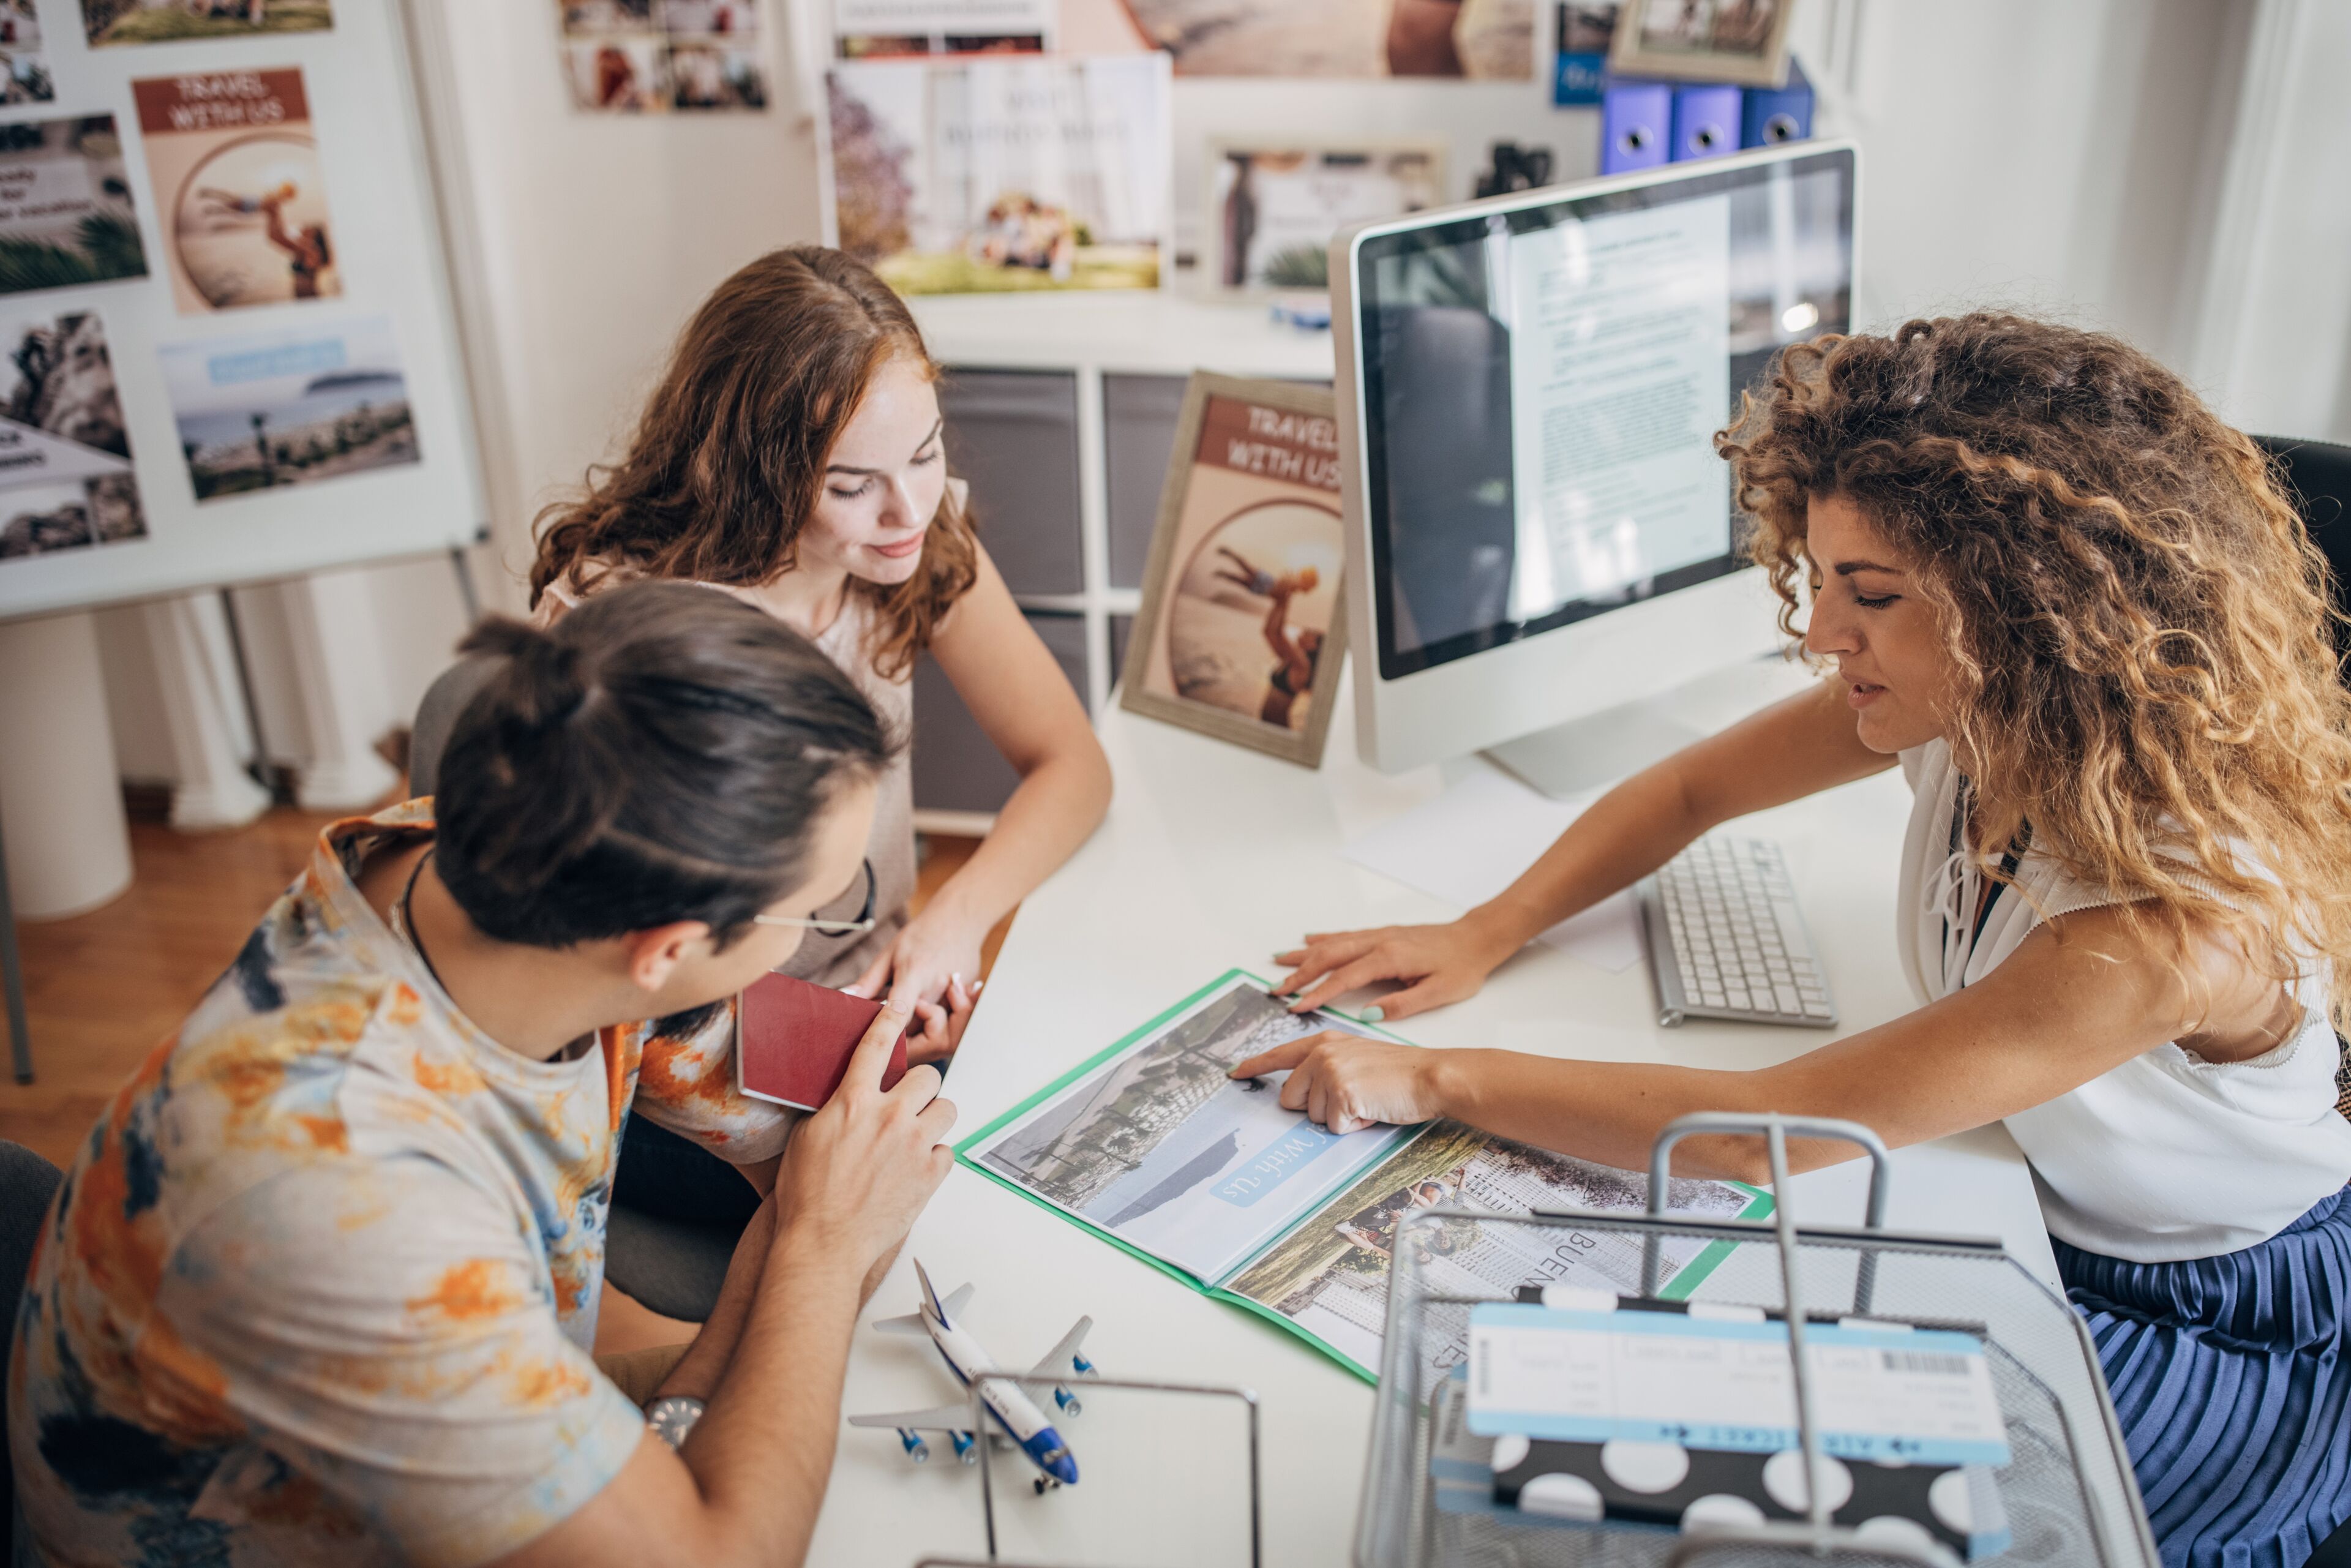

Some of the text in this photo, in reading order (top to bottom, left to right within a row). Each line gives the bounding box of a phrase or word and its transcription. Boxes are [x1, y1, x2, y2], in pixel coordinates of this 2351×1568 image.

[175, 73, 270, 102] TRAVEL
[168, 95, 285, 130] WITH US
[1247, 405, 1339, 451] TRAVEL
[1228, 438, 1341, 487] WITH US
[1223, 1138, 1314, 1198] With Us
[1709, 1424, 1802, 1449] ICKET
